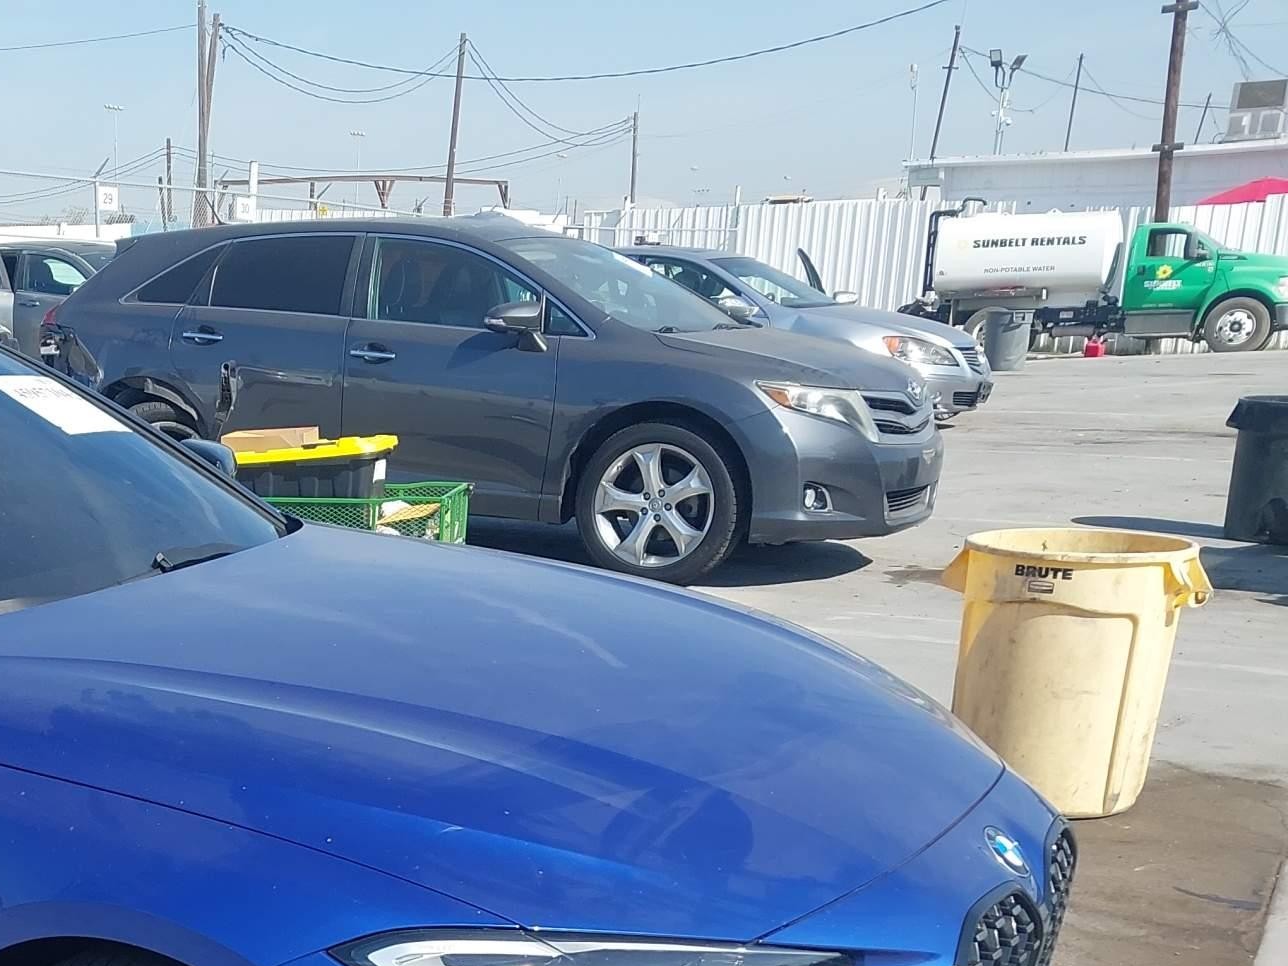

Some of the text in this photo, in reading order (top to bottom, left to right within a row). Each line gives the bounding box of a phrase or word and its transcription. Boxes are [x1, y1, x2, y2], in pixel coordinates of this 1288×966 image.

[103, 192, 113, 205] 29
[972, 235, 1087, 249] SUNBELT RENTALS
[983, 265, 1056, 274] NON-POTABLE WATER
[1014, 564, 1074, 580] BRUTE
